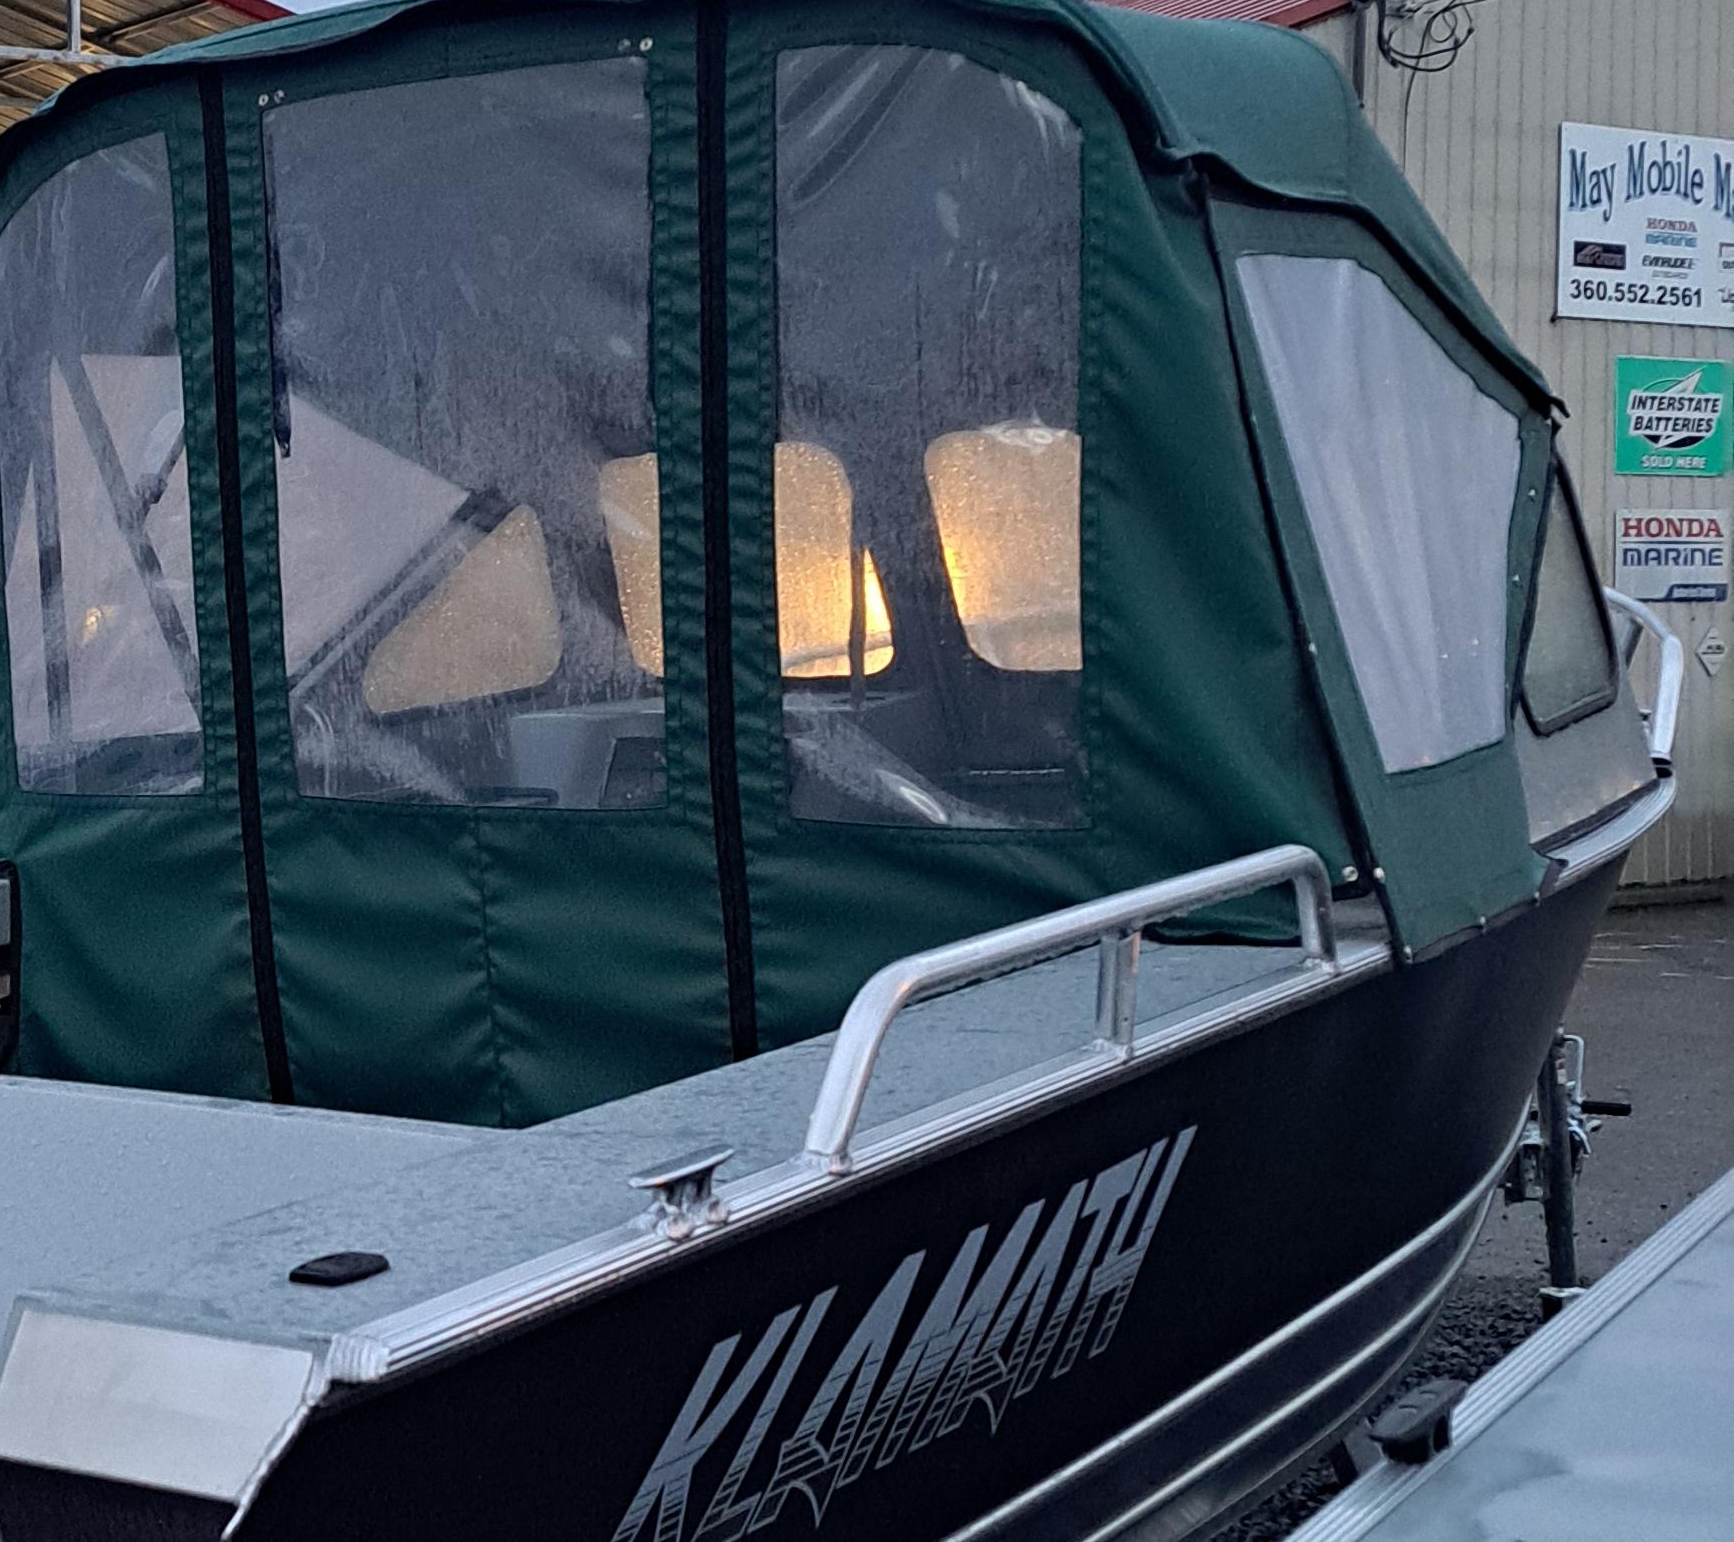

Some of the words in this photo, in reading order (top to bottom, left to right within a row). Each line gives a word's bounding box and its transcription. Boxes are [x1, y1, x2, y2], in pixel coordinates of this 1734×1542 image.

[1569, 148, 1616, 223] May
[1624, 139, 1704, 205] Mobile
[1646, 217, 1697, 233] HONDA
[1570, 278, 1702, 308] 360.552.2561
[1630, 394, 1721, 414] INTERSTATE
[1633, 415, 1714, 434] BATTERIES
[1641, 455, 1673, 468] SOLD
[1676, 456, 1707, 470] HERE
[1621, 517, 1724, 538] HONDA
